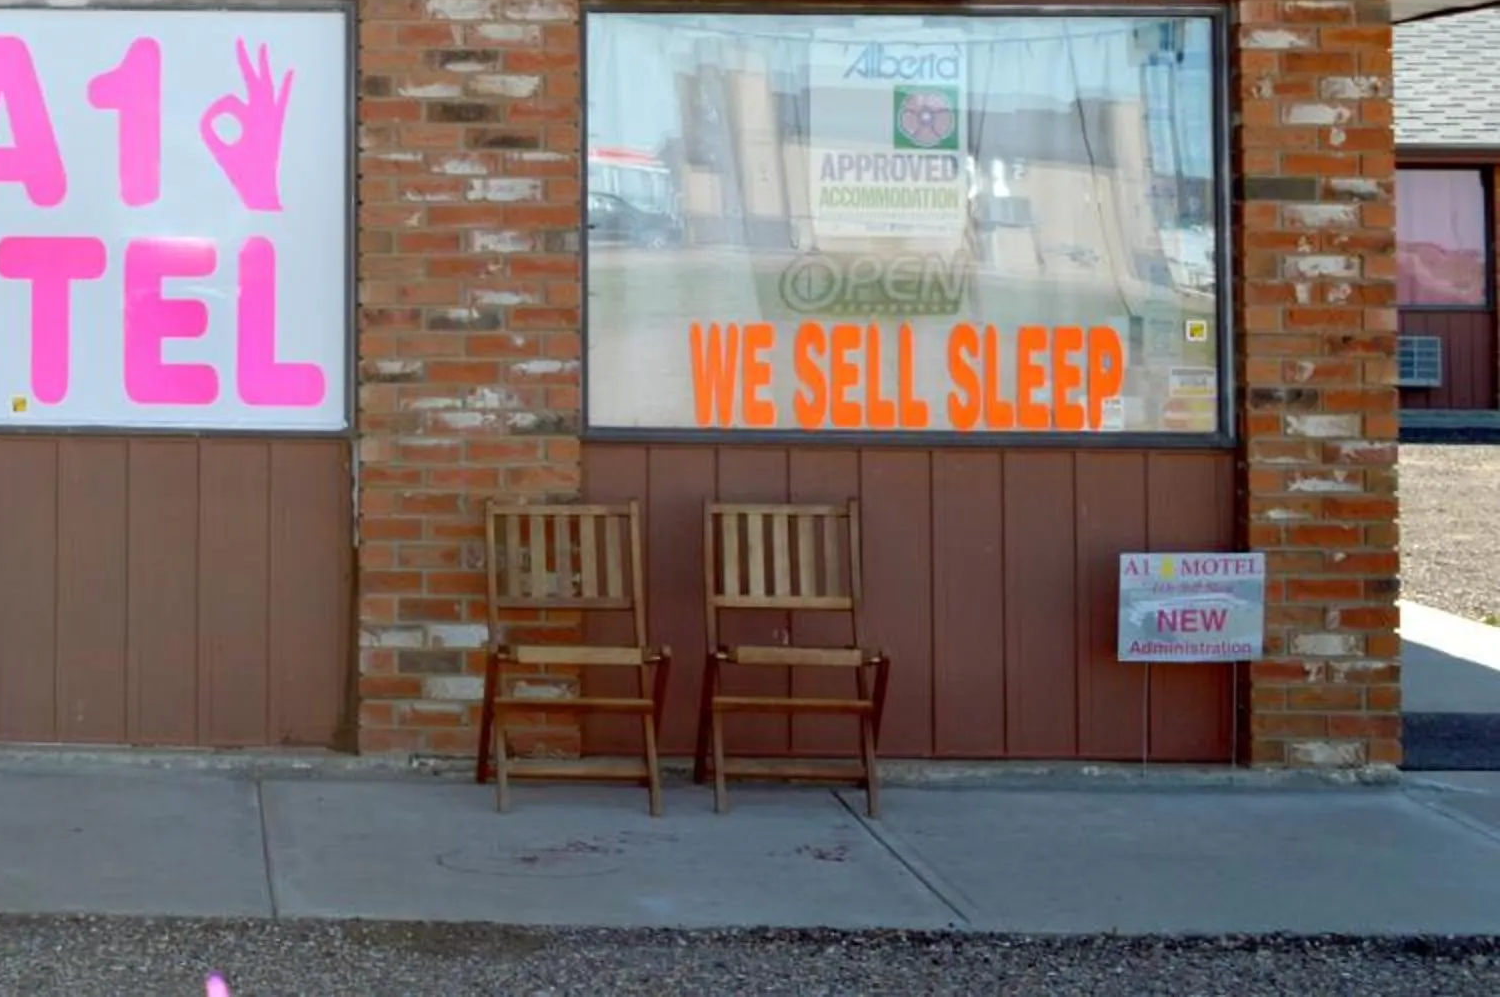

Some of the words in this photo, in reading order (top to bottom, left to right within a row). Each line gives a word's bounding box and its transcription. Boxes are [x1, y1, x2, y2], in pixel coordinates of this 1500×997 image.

[843, 42, 960, 80] Alberta
[820, 153, 960, 182] APPROVED
[819, 185, 960, 209] ACCOMMODATION
[783, 254, 967, 313] OPEN
[689, 321, 775, 428] WE
[793, 320, 929, 430] SELL
[947, 322, 1124, 432] SLEEP
[1180, 557, 1261, 576] MOTEL
[1157, 609, 1229, 633] NEW
[1130, 639, 1252, 655] Administration
